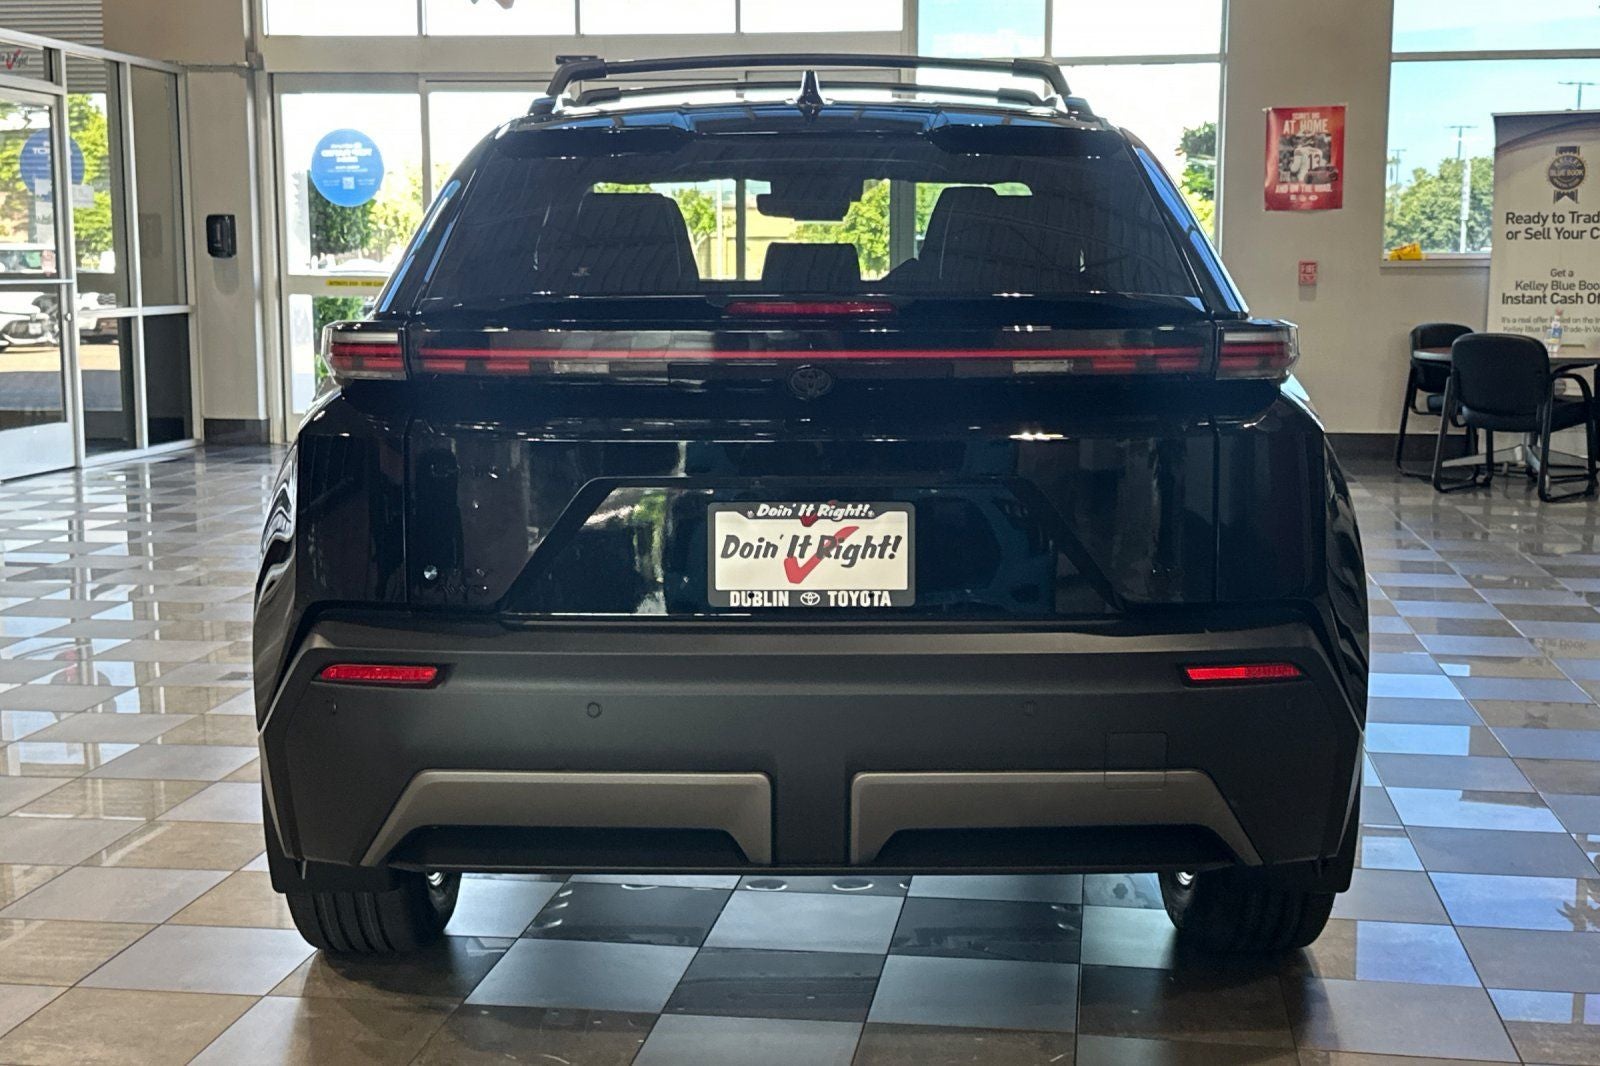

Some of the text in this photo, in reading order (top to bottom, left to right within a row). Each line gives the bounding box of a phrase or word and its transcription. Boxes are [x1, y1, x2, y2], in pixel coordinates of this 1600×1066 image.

[1283, 119, 1328, 134] AT HOME
[1505, 211, 1549, 227] Ready
[1552, 212, 1565, 224] to
[1506, 230, 1521, 240] or
[1524, 227, 1551, 240] Sell
[1554, 227, 1587, 240] Your
[1550, 268, 1566, 277] Get
[1515, 280, 1548, 293] Kelley
[1551, 280, 1576, 291] Blue
[1502, 292, 1547, 304] Instant
[1550, 292, 1584, 304] Cash
[756, 503, 869, 522] Doin' It Right!
[720, 534, 903, 568] Doin' It Right!
[729, 590, 891, 607] DUBLIN TOYOTA
